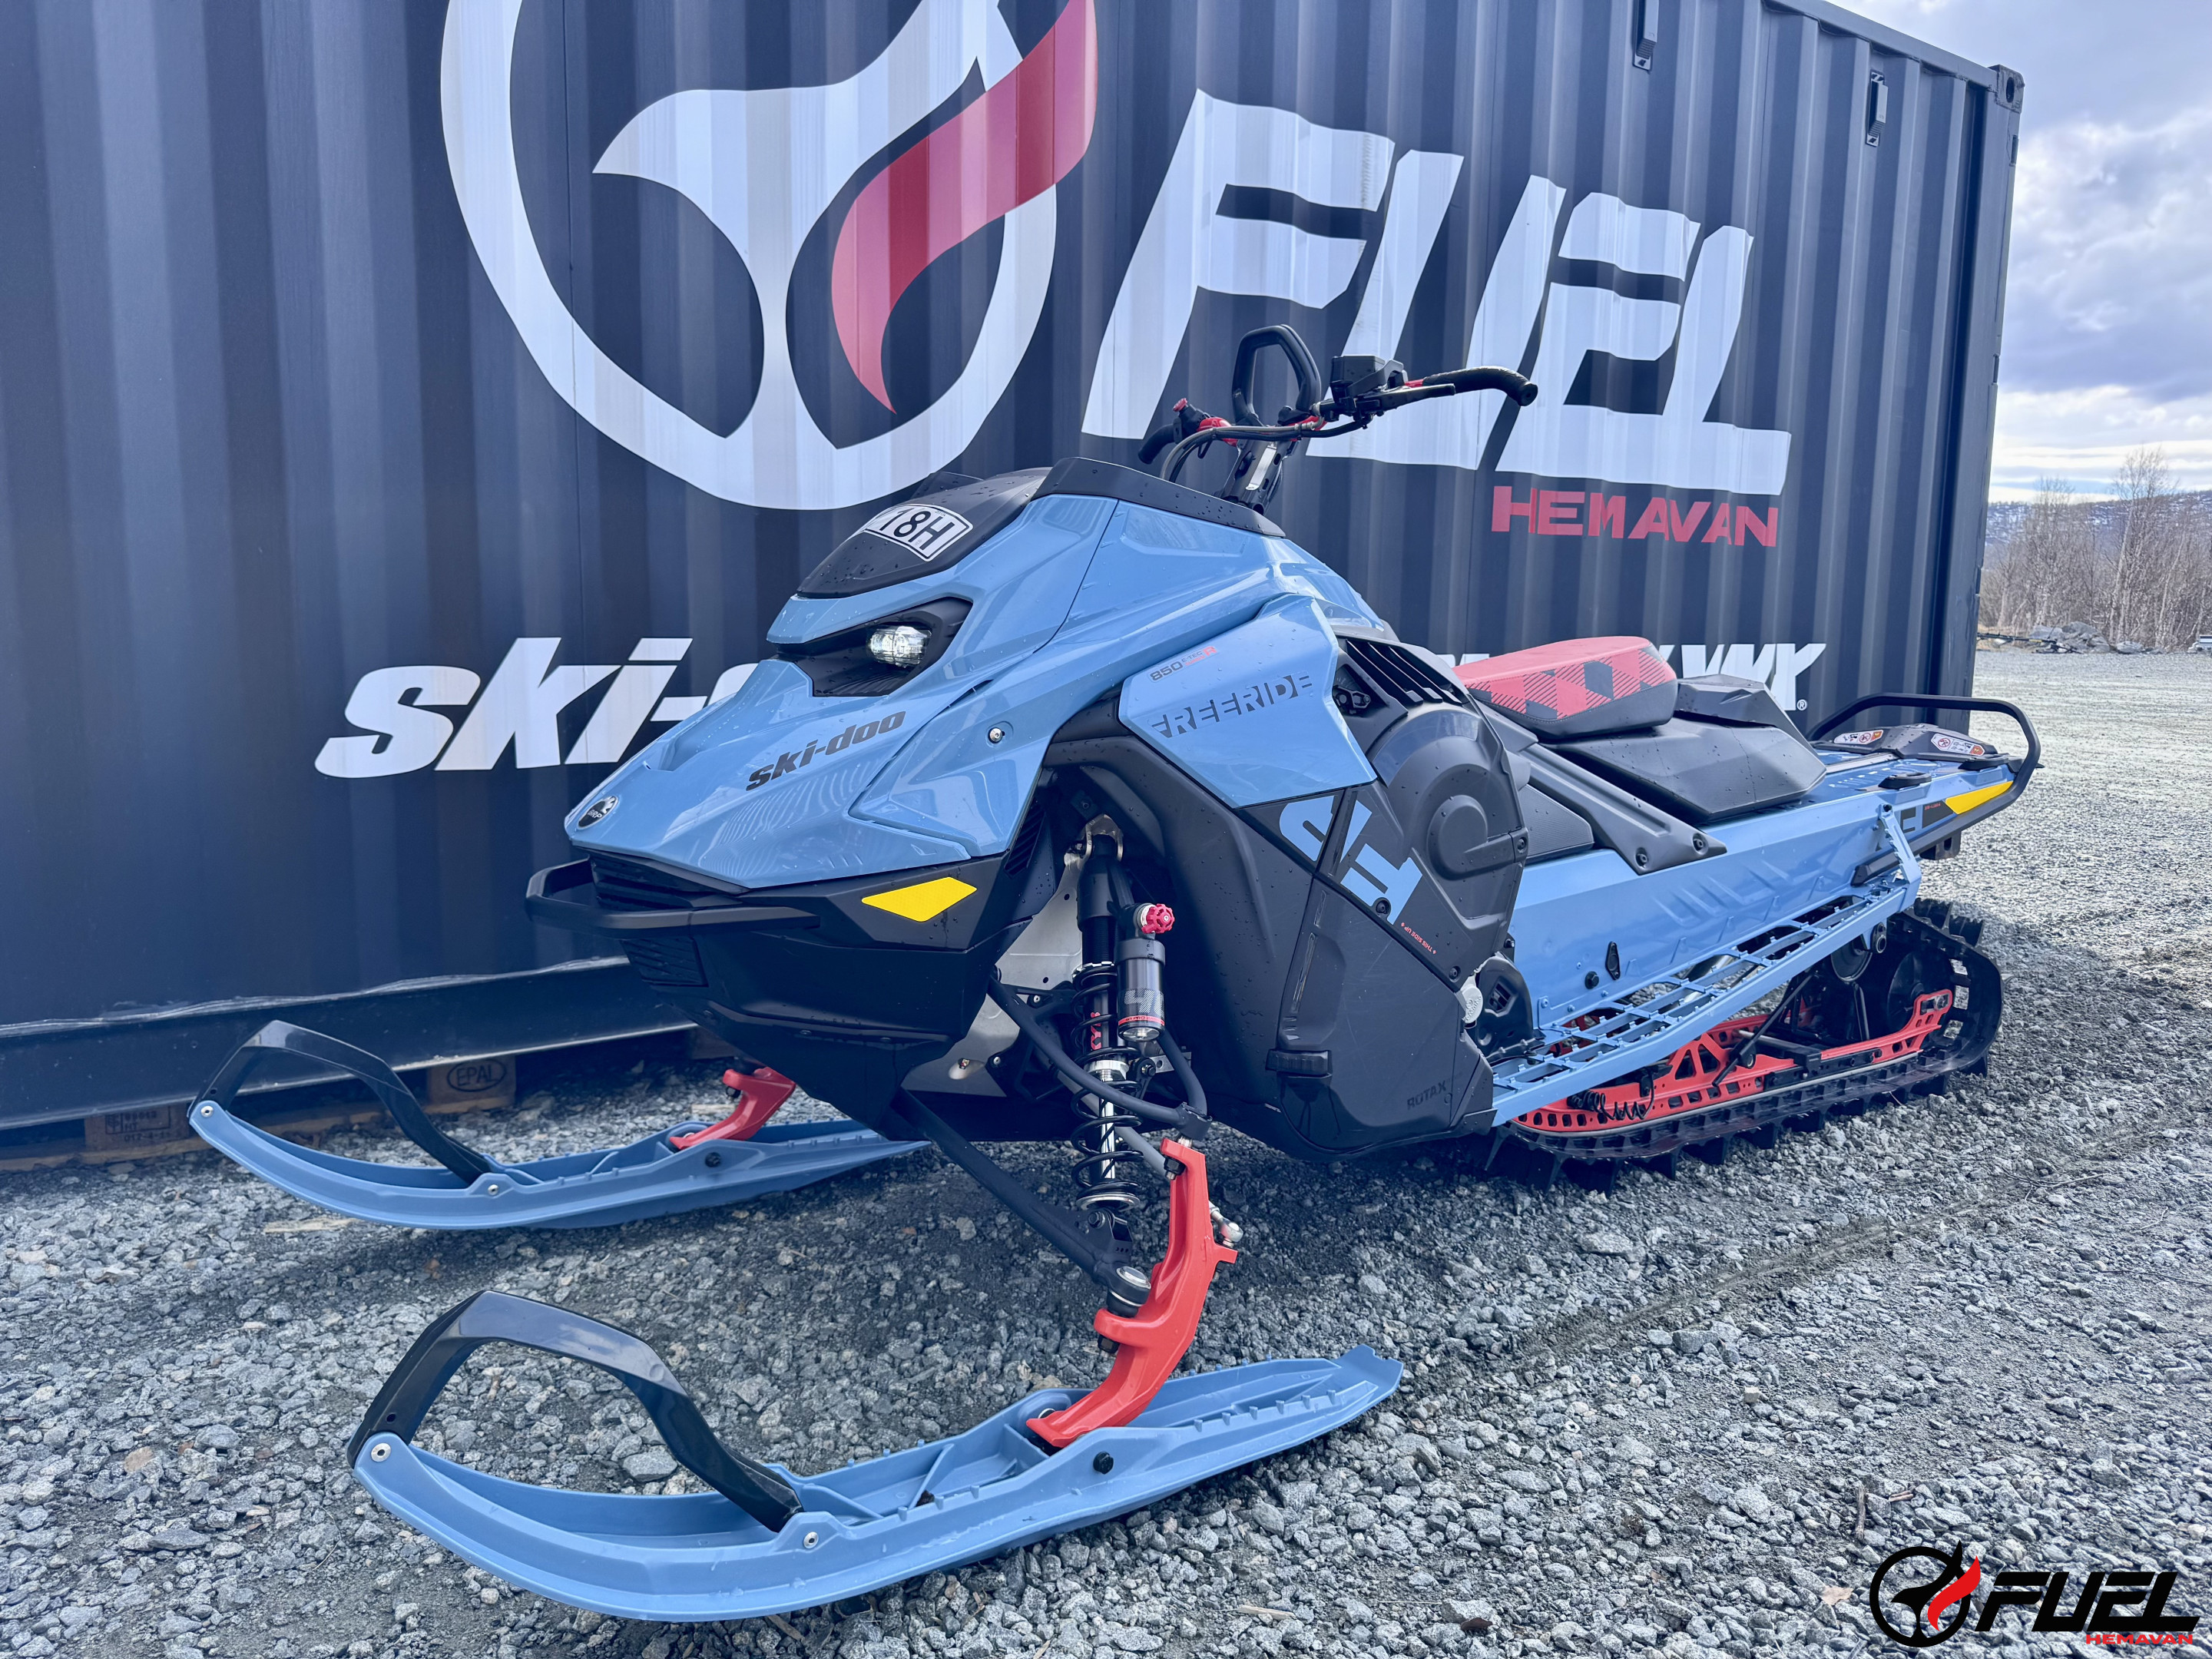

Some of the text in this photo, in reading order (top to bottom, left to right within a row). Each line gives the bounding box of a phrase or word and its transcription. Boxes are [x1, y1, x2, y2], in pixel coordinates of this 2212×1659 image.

[1081, 88, 1791, 495] FUEL
[1492, 486, 1778, 547] HEMAVAN
[1150, 661, 1183, 681] 850
[1149, 674, 1313, 738] FREERIDE
[746, 710, 906, 791] ski-doo
[587, 809, 603, 819] BRP
[1410, 931, 1423, 943] SIDE
[1421, 940, 1433, 952] THIS
[456, 1064, 500, 1087] EPAL
[1406, 1079, 1446, 1111] ROTAX
